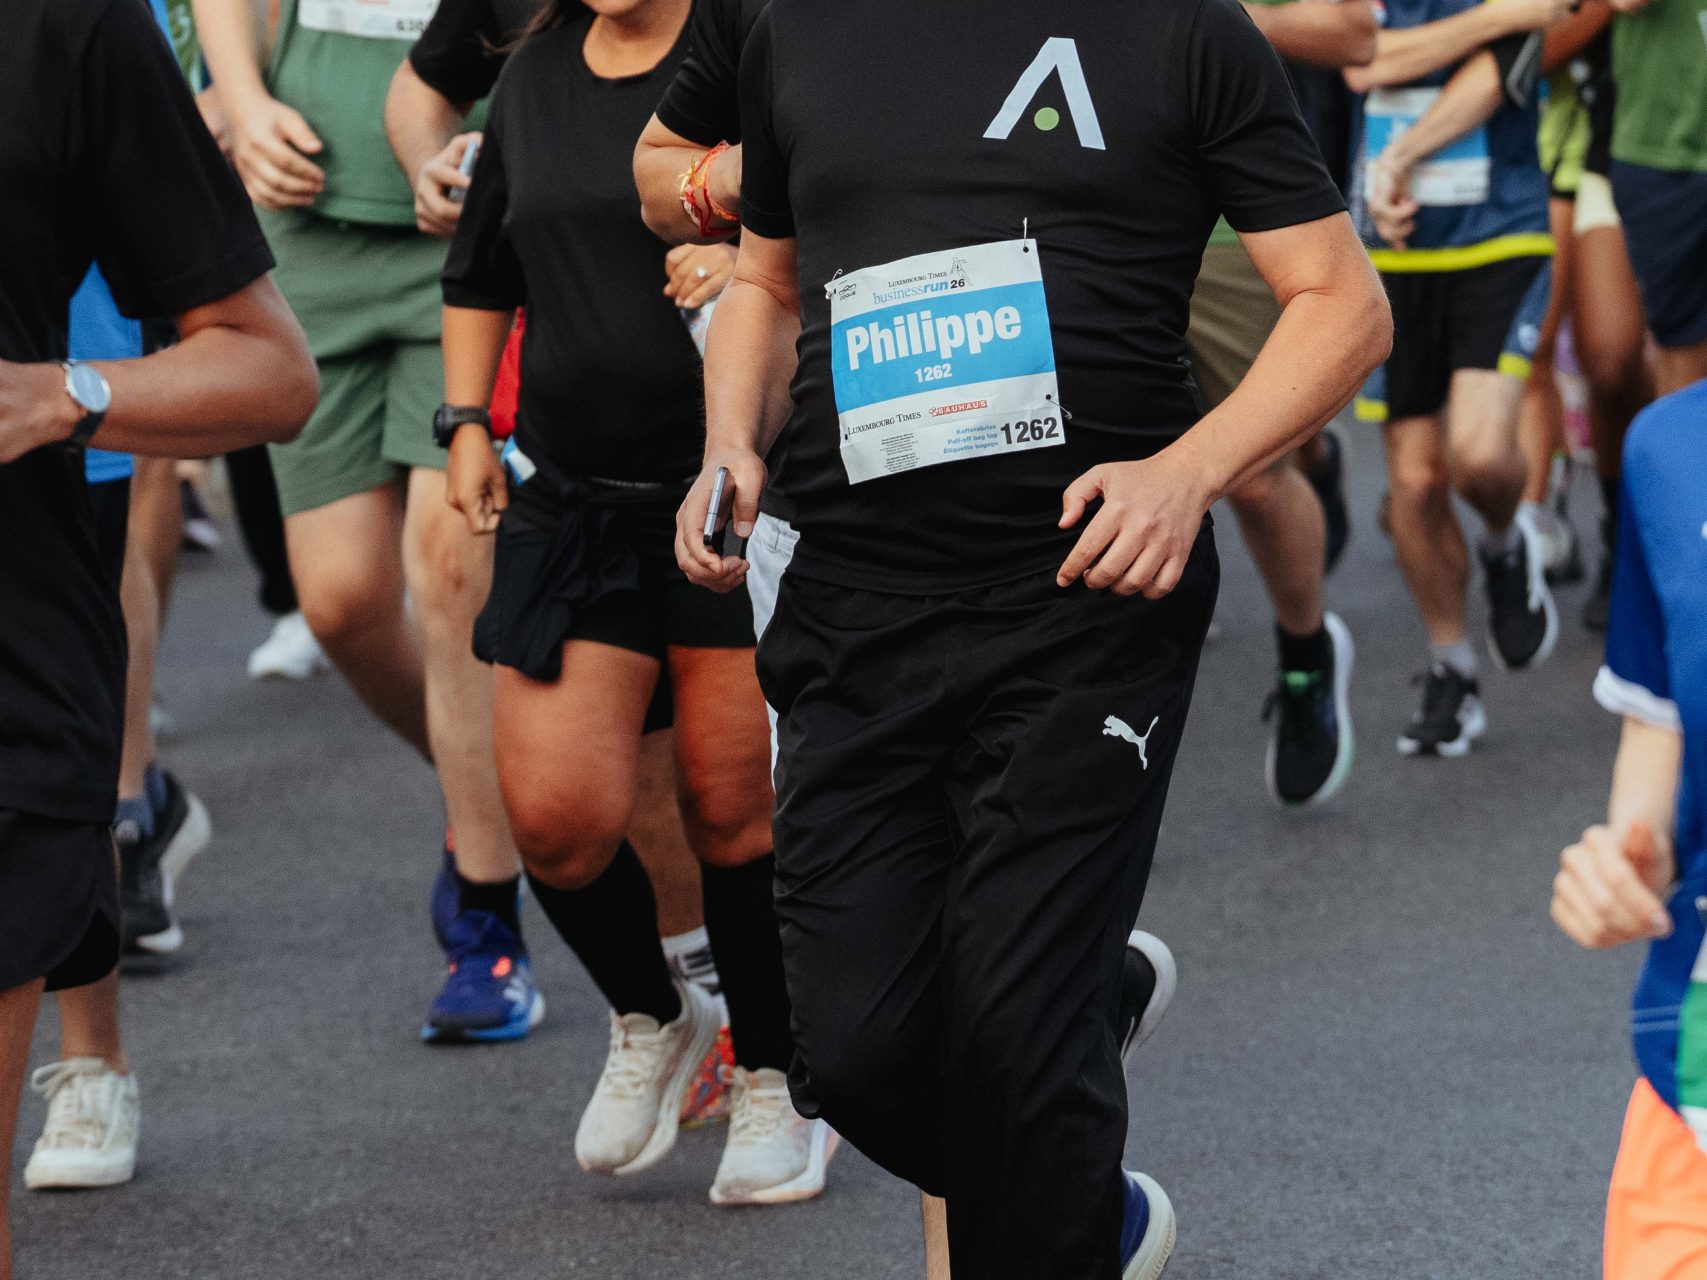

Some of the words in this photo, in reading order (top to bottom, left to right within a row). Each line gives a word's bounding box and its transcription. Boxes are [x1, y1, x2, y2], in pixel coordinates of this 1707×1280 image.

[846, 305, 1022, 371] Philippe
[915, 363, 953, 384] 1262
[937, 400, 988, 416] BAUHAUS
[847, 417, 896, 436] LUXEMBOURG
[896, 411, 922, 423] TIMES
[1000, 417, 1060, 446] 1262
[973, 434, 986, 442] bag
